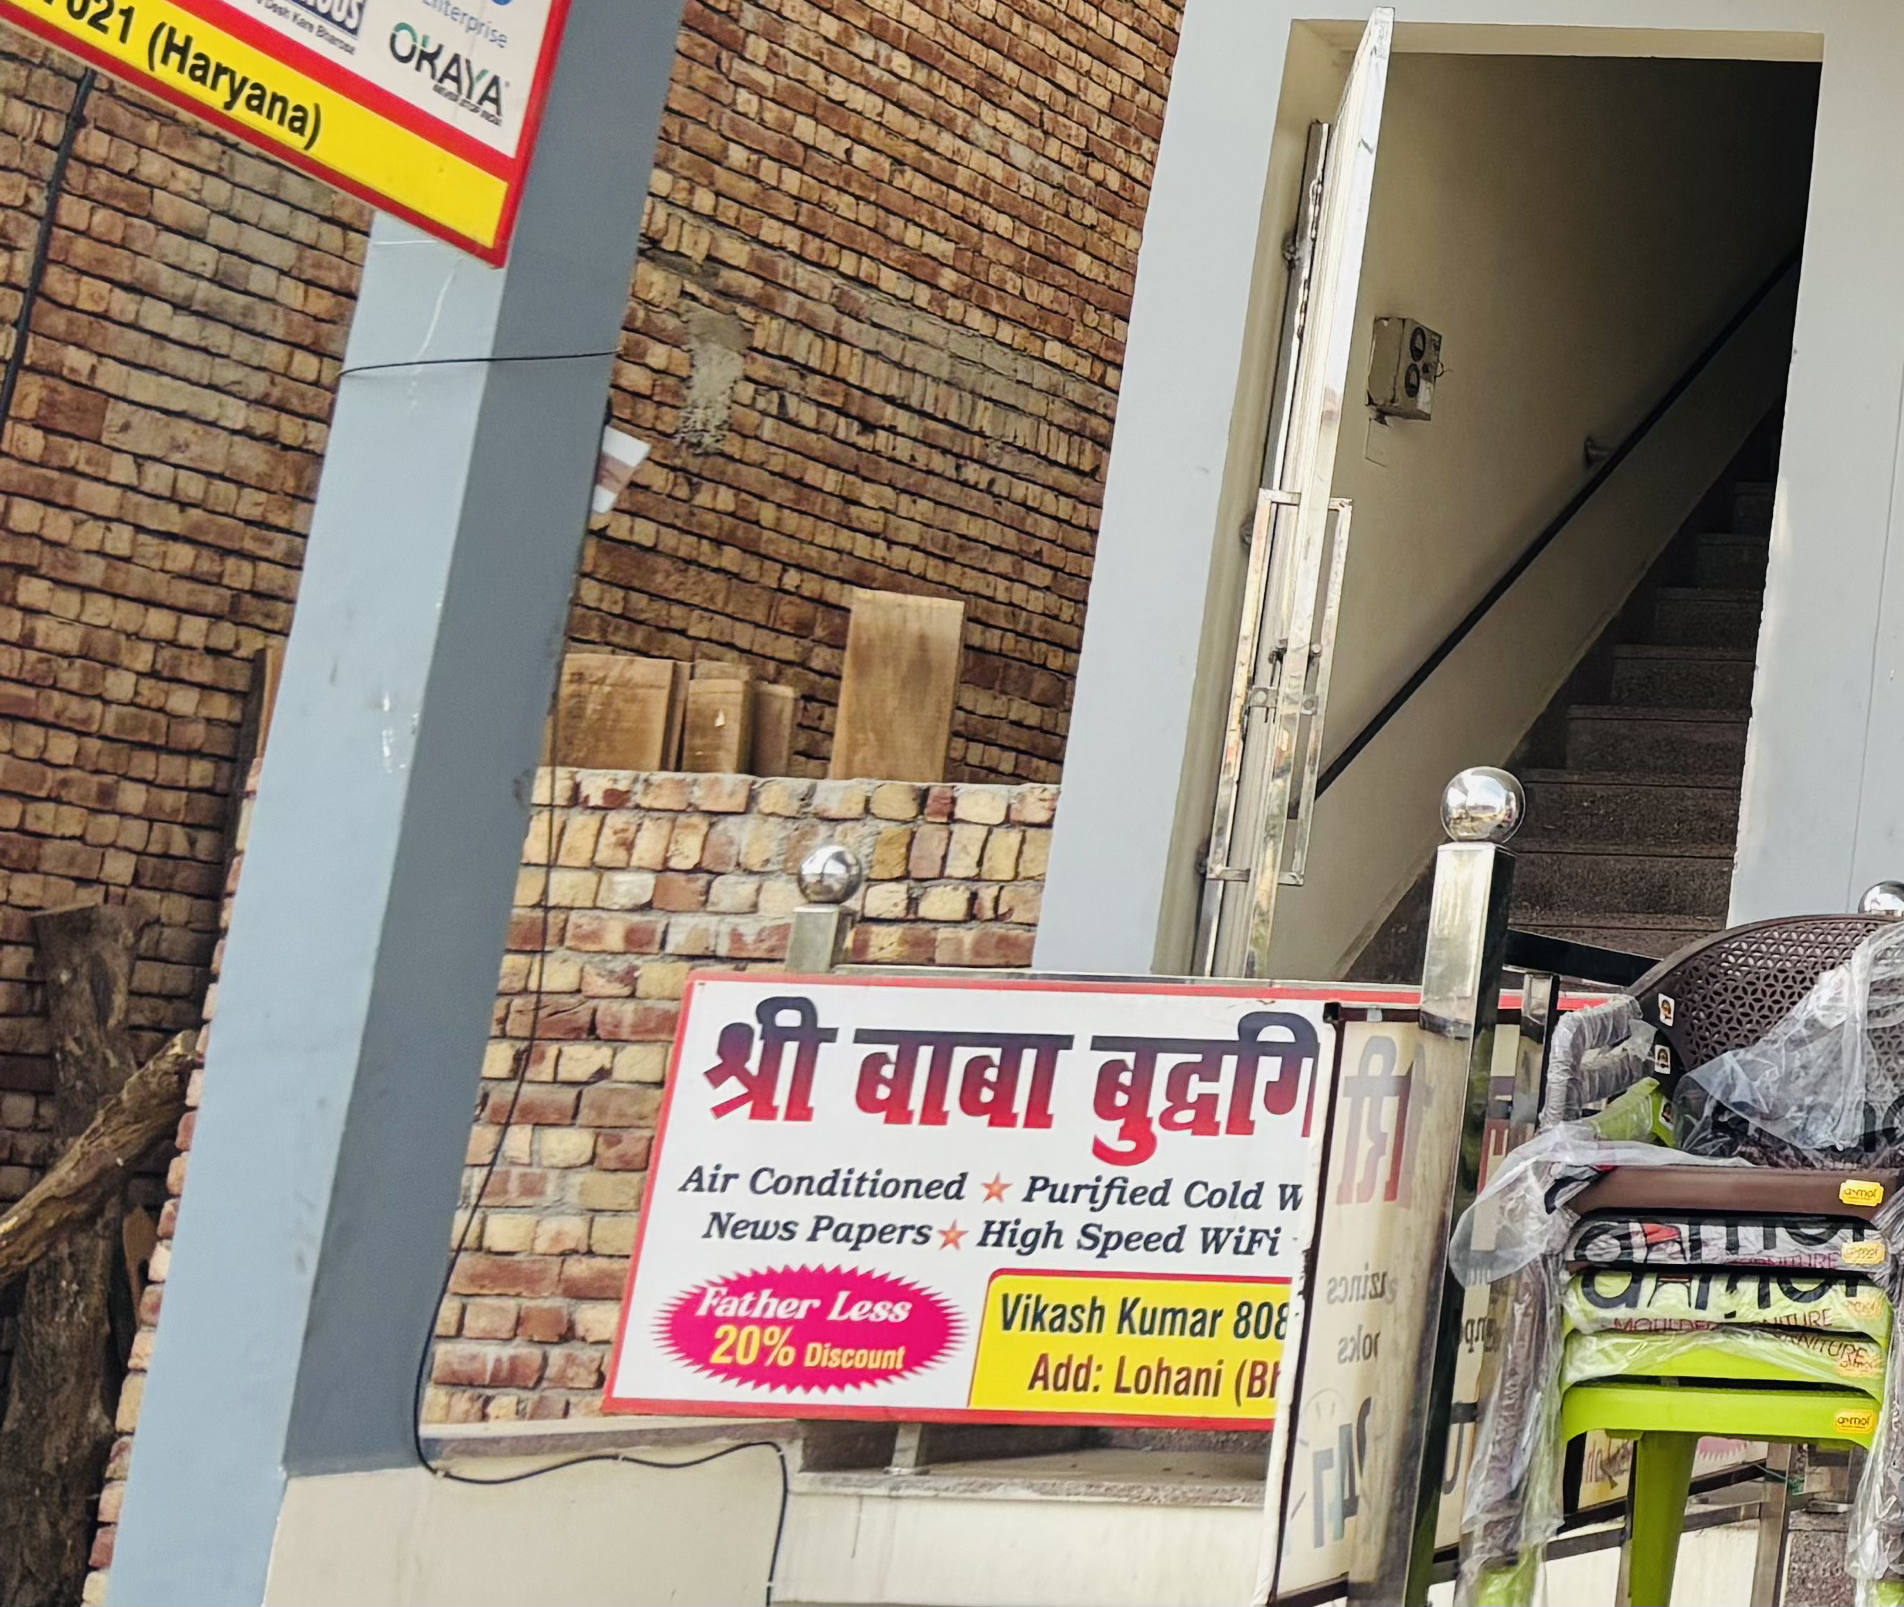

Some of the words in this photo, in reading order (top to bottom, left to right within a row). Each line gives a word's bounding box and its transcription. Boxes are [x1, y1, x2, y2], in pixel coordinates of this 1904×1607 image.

[148, 20, 322, 152] (Haryana)
[389, 21, 503, 117] OKAYA
[703, 995, 838, 1124] श्री
[853, 1027, 1074, 1132] बाबा
[678, 1165, 741, 1197] Air
[749, 1167, 969, 1202] Conditioned
[1021, 1174, 1170, 1212] Purified
[1183, 1179, 1264, 1211] Cold
[703, 1211, 798, 1242] News
[806, 1215, 932, 1252] Papers
[977, 1218, 1064, 1254] High
[1077, 1224, 1186, 1259] Speed
[1200, 1226, 1282, 1257] WiFi
[696, 1287, 816, 1322] Father
[826, 1290, 911, 1324] Less
[1000, 1290, 1105, 1337] Vikash
[1116, 1296, 1224, 1339] Kumar
[711, 1325, 796, 1368] 20%
[803, 1342, 905, 1372] Discount
[1028, 1353, 1103, 1394] Add:
[1114, 1356, 1223, 1399] Lohani
